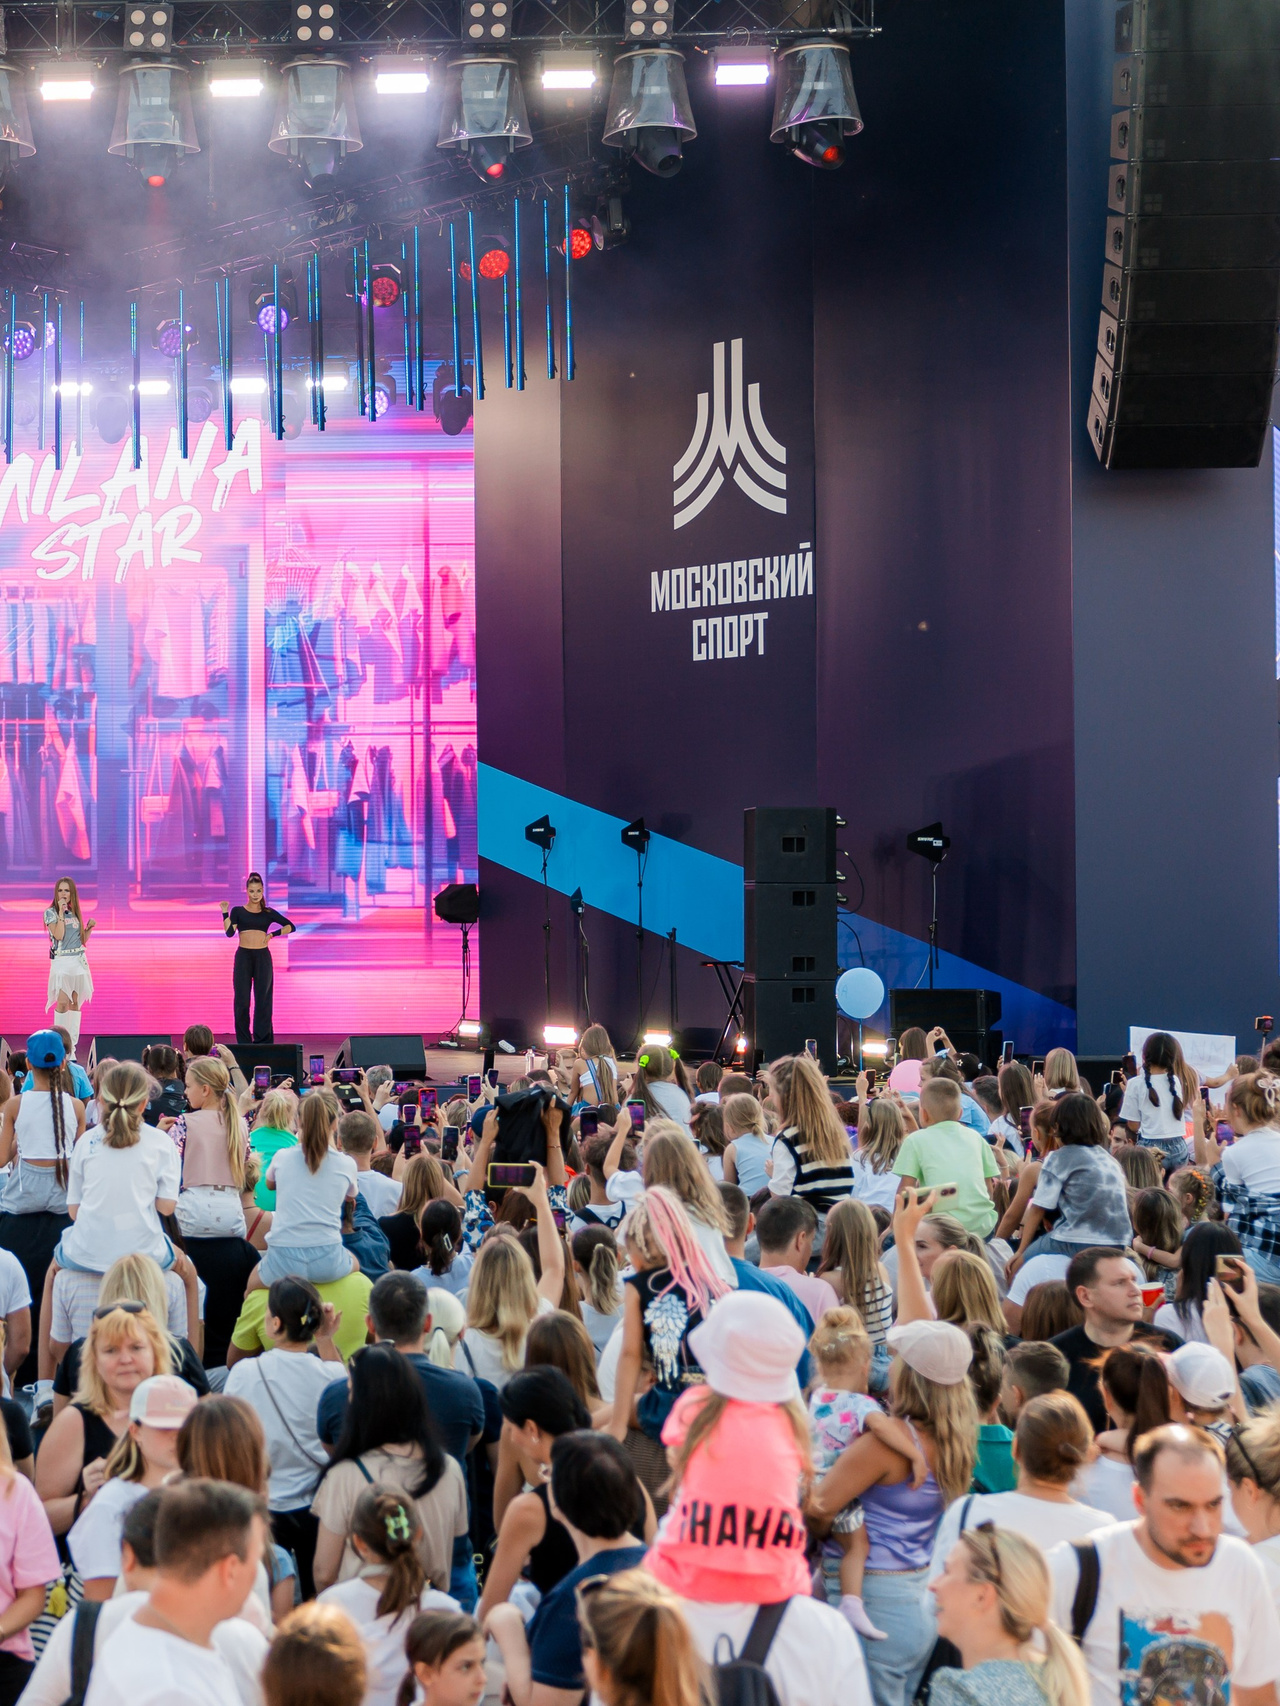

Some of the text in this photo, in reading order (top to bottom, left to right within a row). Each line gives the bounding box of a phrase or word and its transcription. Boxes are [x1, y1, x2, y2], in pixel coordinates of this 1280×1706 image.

[30, 504, 204, 584] STAR
[650, 541, 814, 613] МОСКОВСКИЙ
[692, 611, 769, 662] СПОРТ
